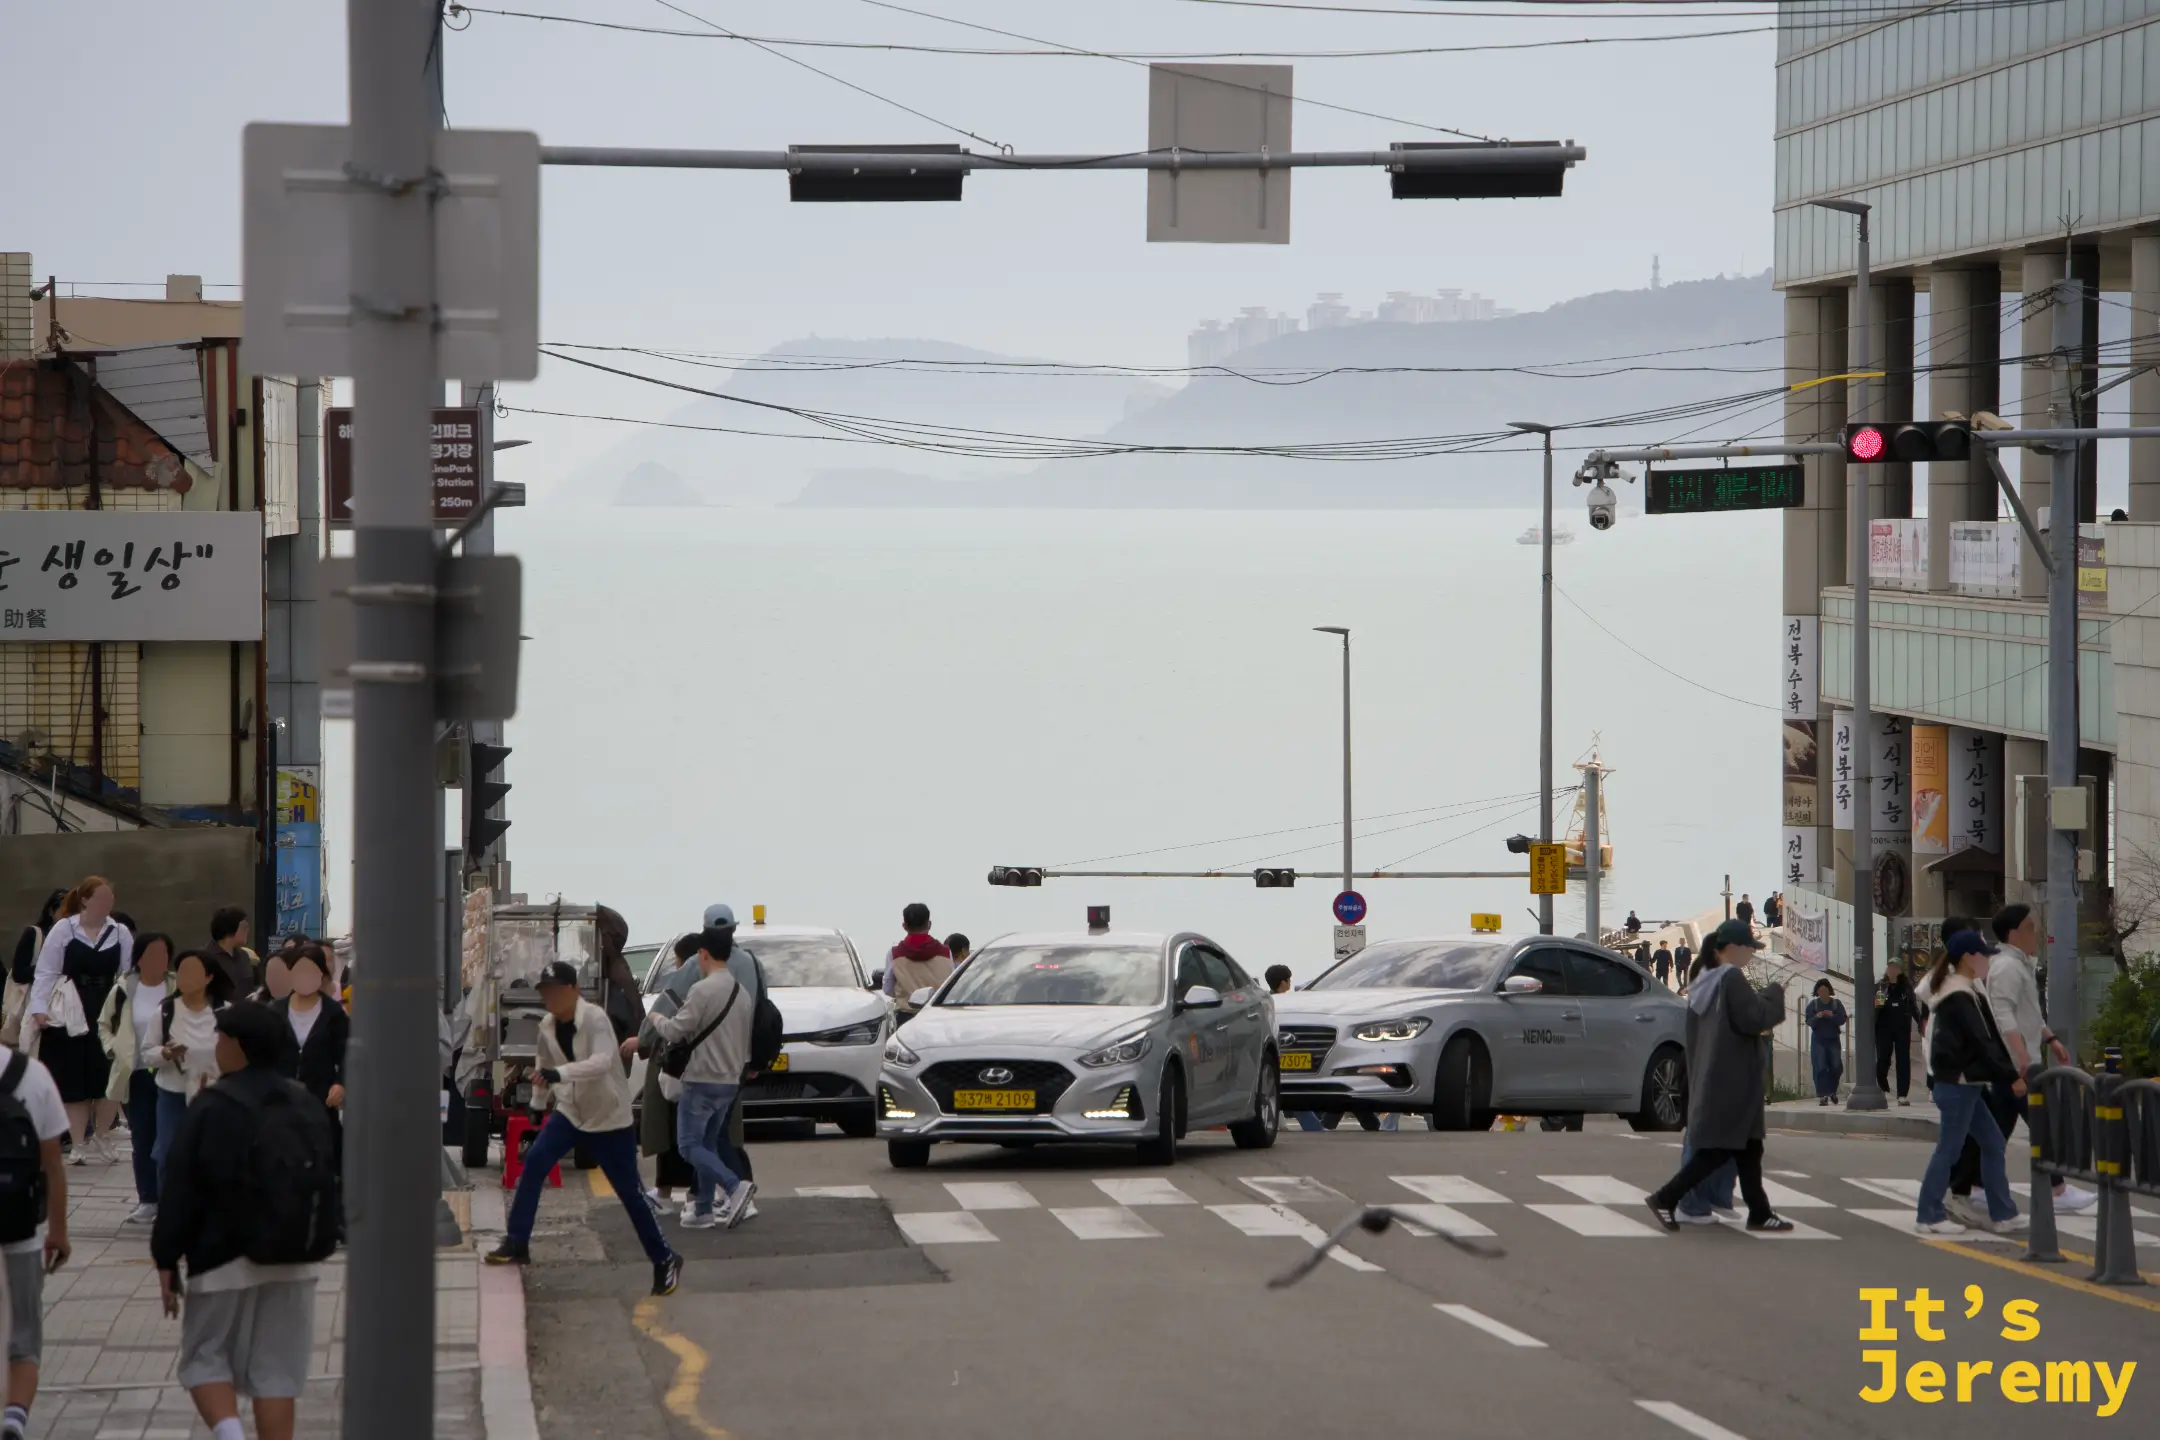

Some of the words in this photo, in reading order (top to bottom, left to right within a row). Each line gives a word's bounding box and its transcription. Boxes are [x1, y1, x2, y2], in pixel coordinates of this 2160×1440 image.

[431, 464, 473, 474] inePark
[437, 478, 473, 487] Station
[440, 497, 472, 507] 250m
[1787, 619, 1803, 714] 전복수육
[1836, 726, 1852, 810] 전복죽
[1881, 715, 1904, 824] 조식가능
[1966, 736, 1989, 844] 부산어묵
[1336, 929, 1364, 938] 견인지역
[1523, 1029, 1553, 1045] NEMO
[1281, 1055, 1308, 1068] 7307
[996, 1092, 1030, 1107] 2109
